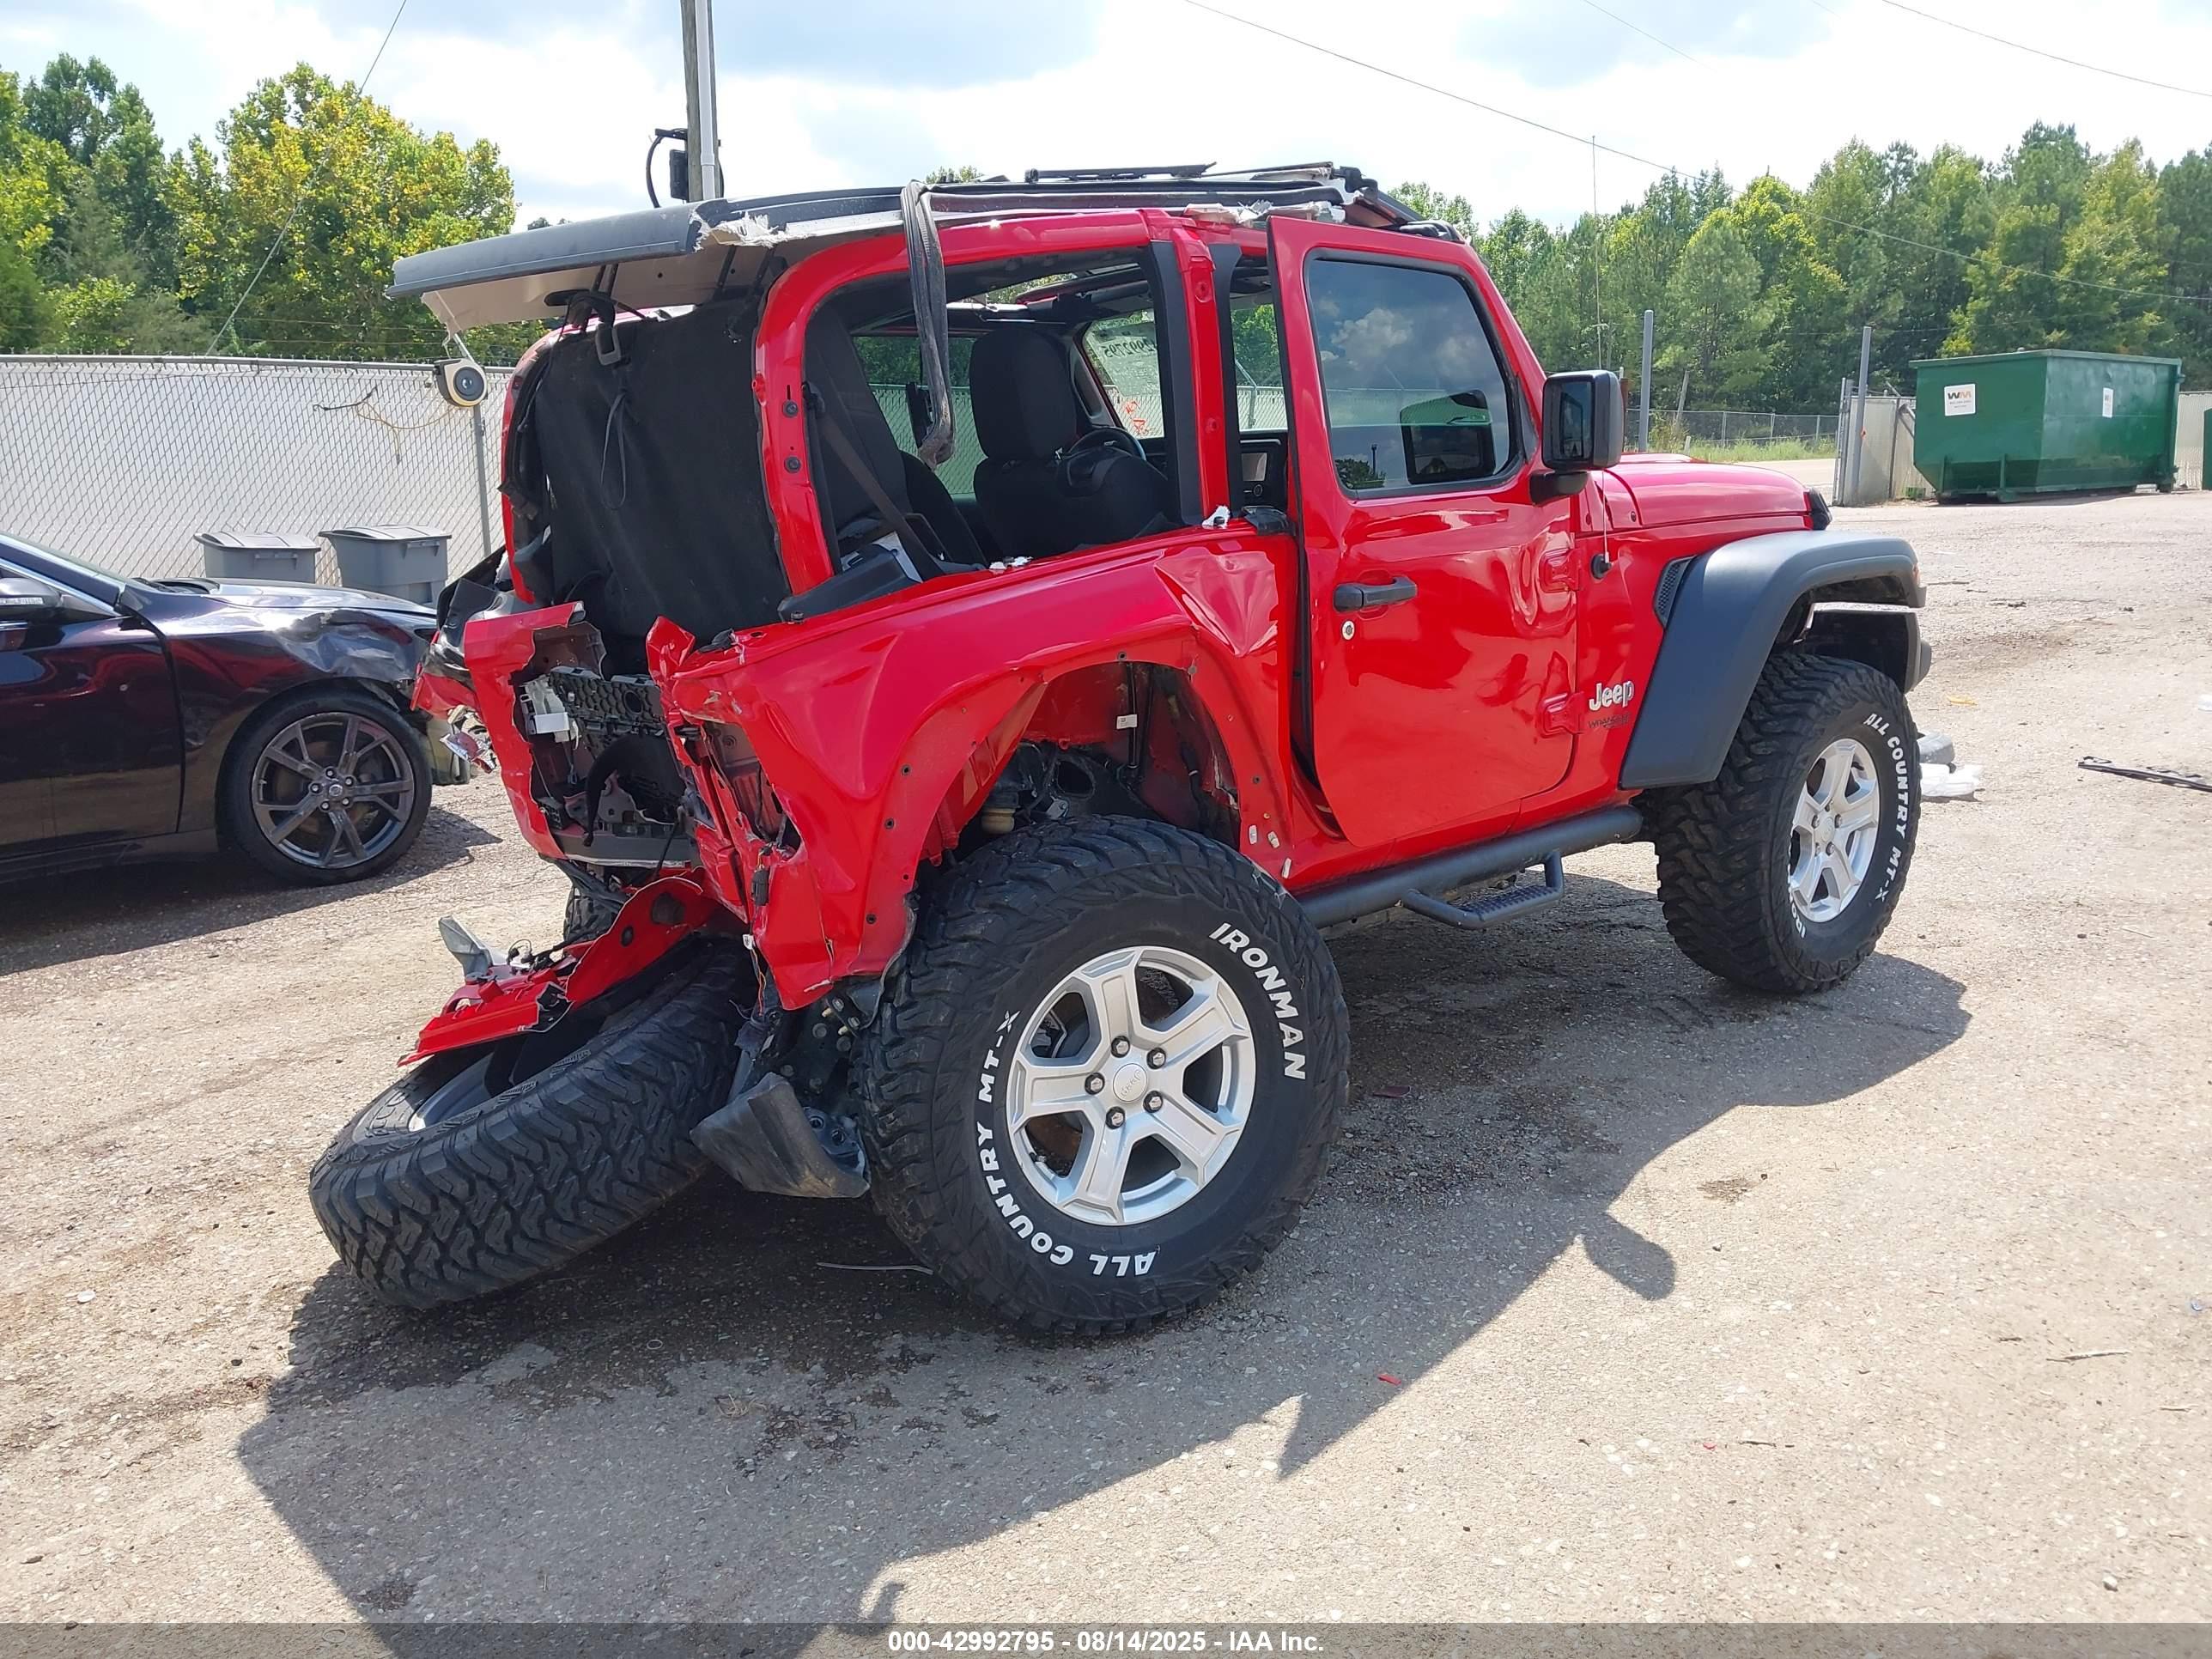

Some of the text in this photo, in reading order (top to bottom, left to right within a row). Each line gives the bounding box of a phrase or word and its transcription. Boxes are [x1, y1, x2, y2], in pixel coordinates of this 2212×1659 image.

[1948, 391, 1972, 399] WM
[1589, 680, 1634, 711] Jeep
[1863, 713, 1911, 902] ALL COUNTRY MT-X
[1208, 922, 1306, 1080] IRONMAN
[976, 1010, 1158, 1277] ALL COUNTRY MT-X
